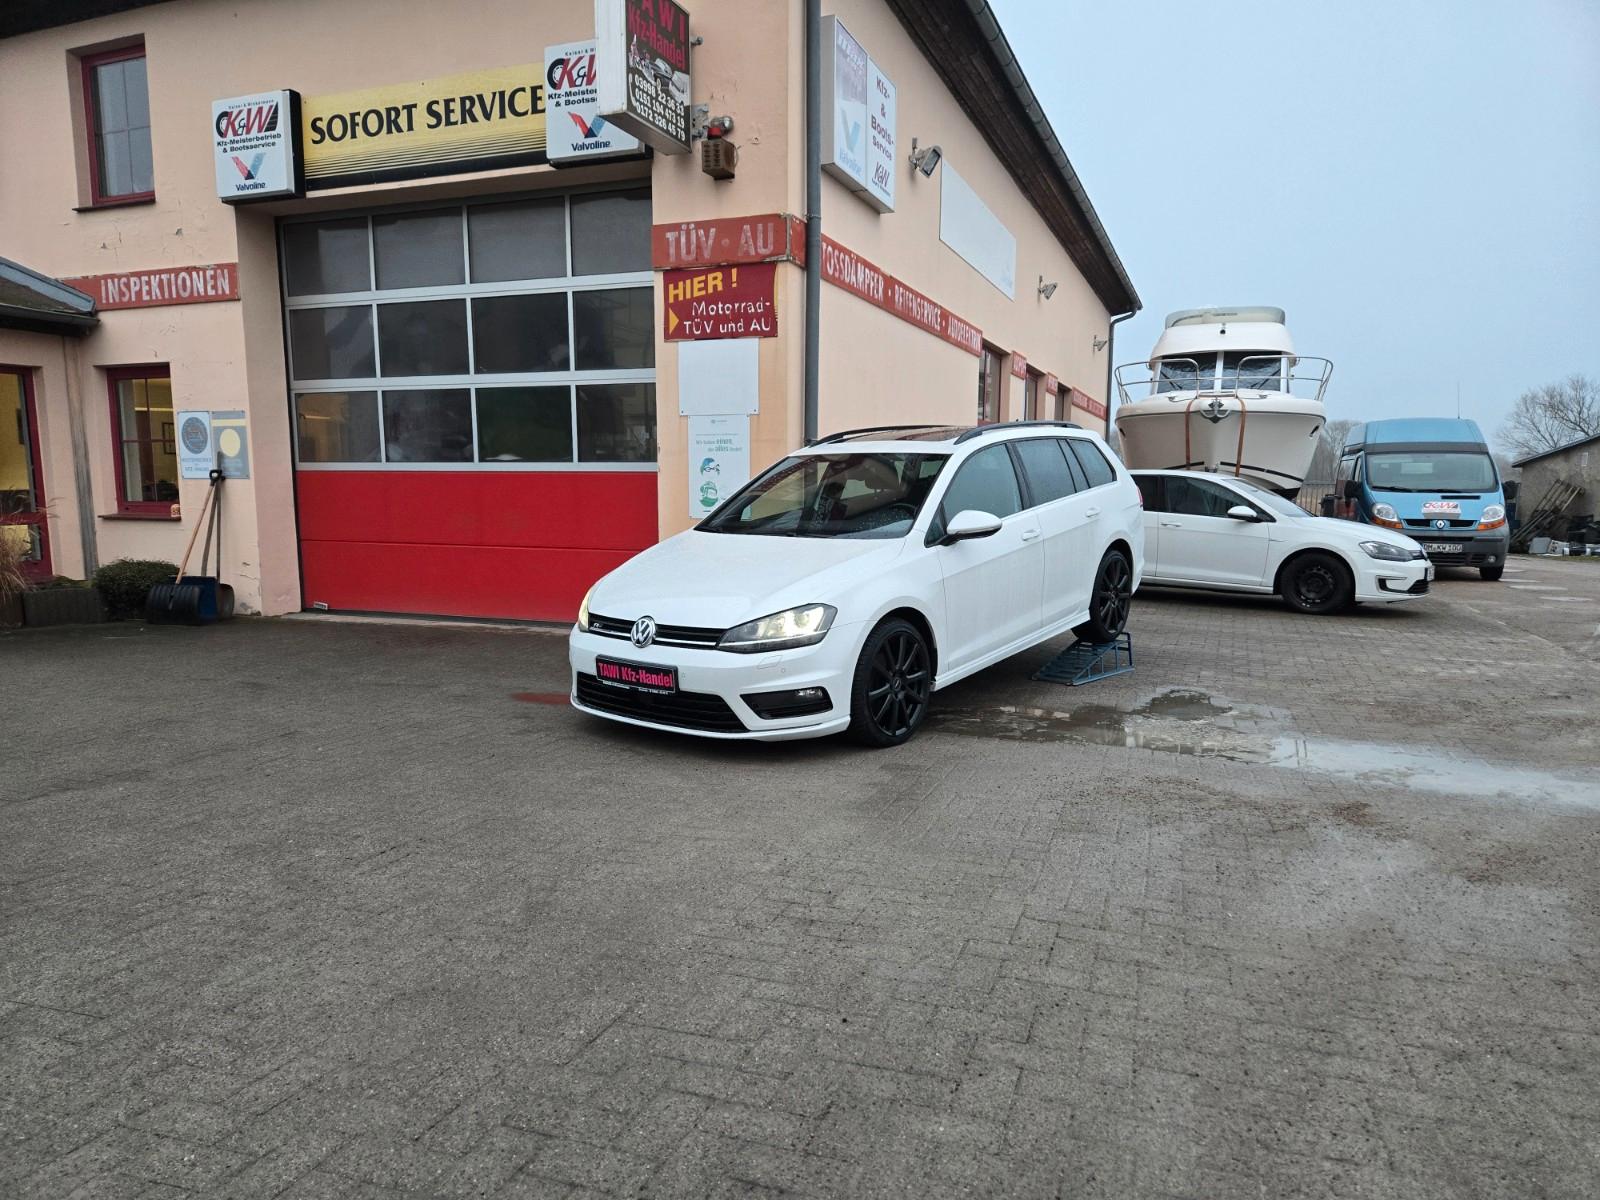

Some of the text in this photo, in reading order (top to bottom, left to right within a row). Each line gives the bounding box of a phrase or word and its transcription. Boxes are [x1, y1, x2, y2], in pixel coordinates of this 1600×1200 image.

[628, 1, 686, 71] Kfz-Handel
[310, 84, 546, 145] SOFORT SERVICE
[635, 88, 652, 108] 0151
[677, 116, 685, 129] 19
[636, 101, 653, 122] 0172
[217, 133, 281, 147] Kfz-Meisterbetrieb
[230, 141, 276, 152] Bootsservice
[571, 140, 611, 151] Valvoline
[236, 182, 266, 191] Valvoline
[665, 223, 774, 262] TÜV AU
[101, 268, 230, 304] INSPEKTIONEN
[668, 271, 723, 304] HIER
[821, 241, 884, 302] TOSSDÄMPFER
[894, 284, 941, 331] REIFENSERVICE
[692, 297, 771, 318] Motorrad-
[683, 316, 771, 335] TÜV und AU
[598, 662, 620, 679] TAWI
[621, 666, 673, 687] Kfz-Handel
